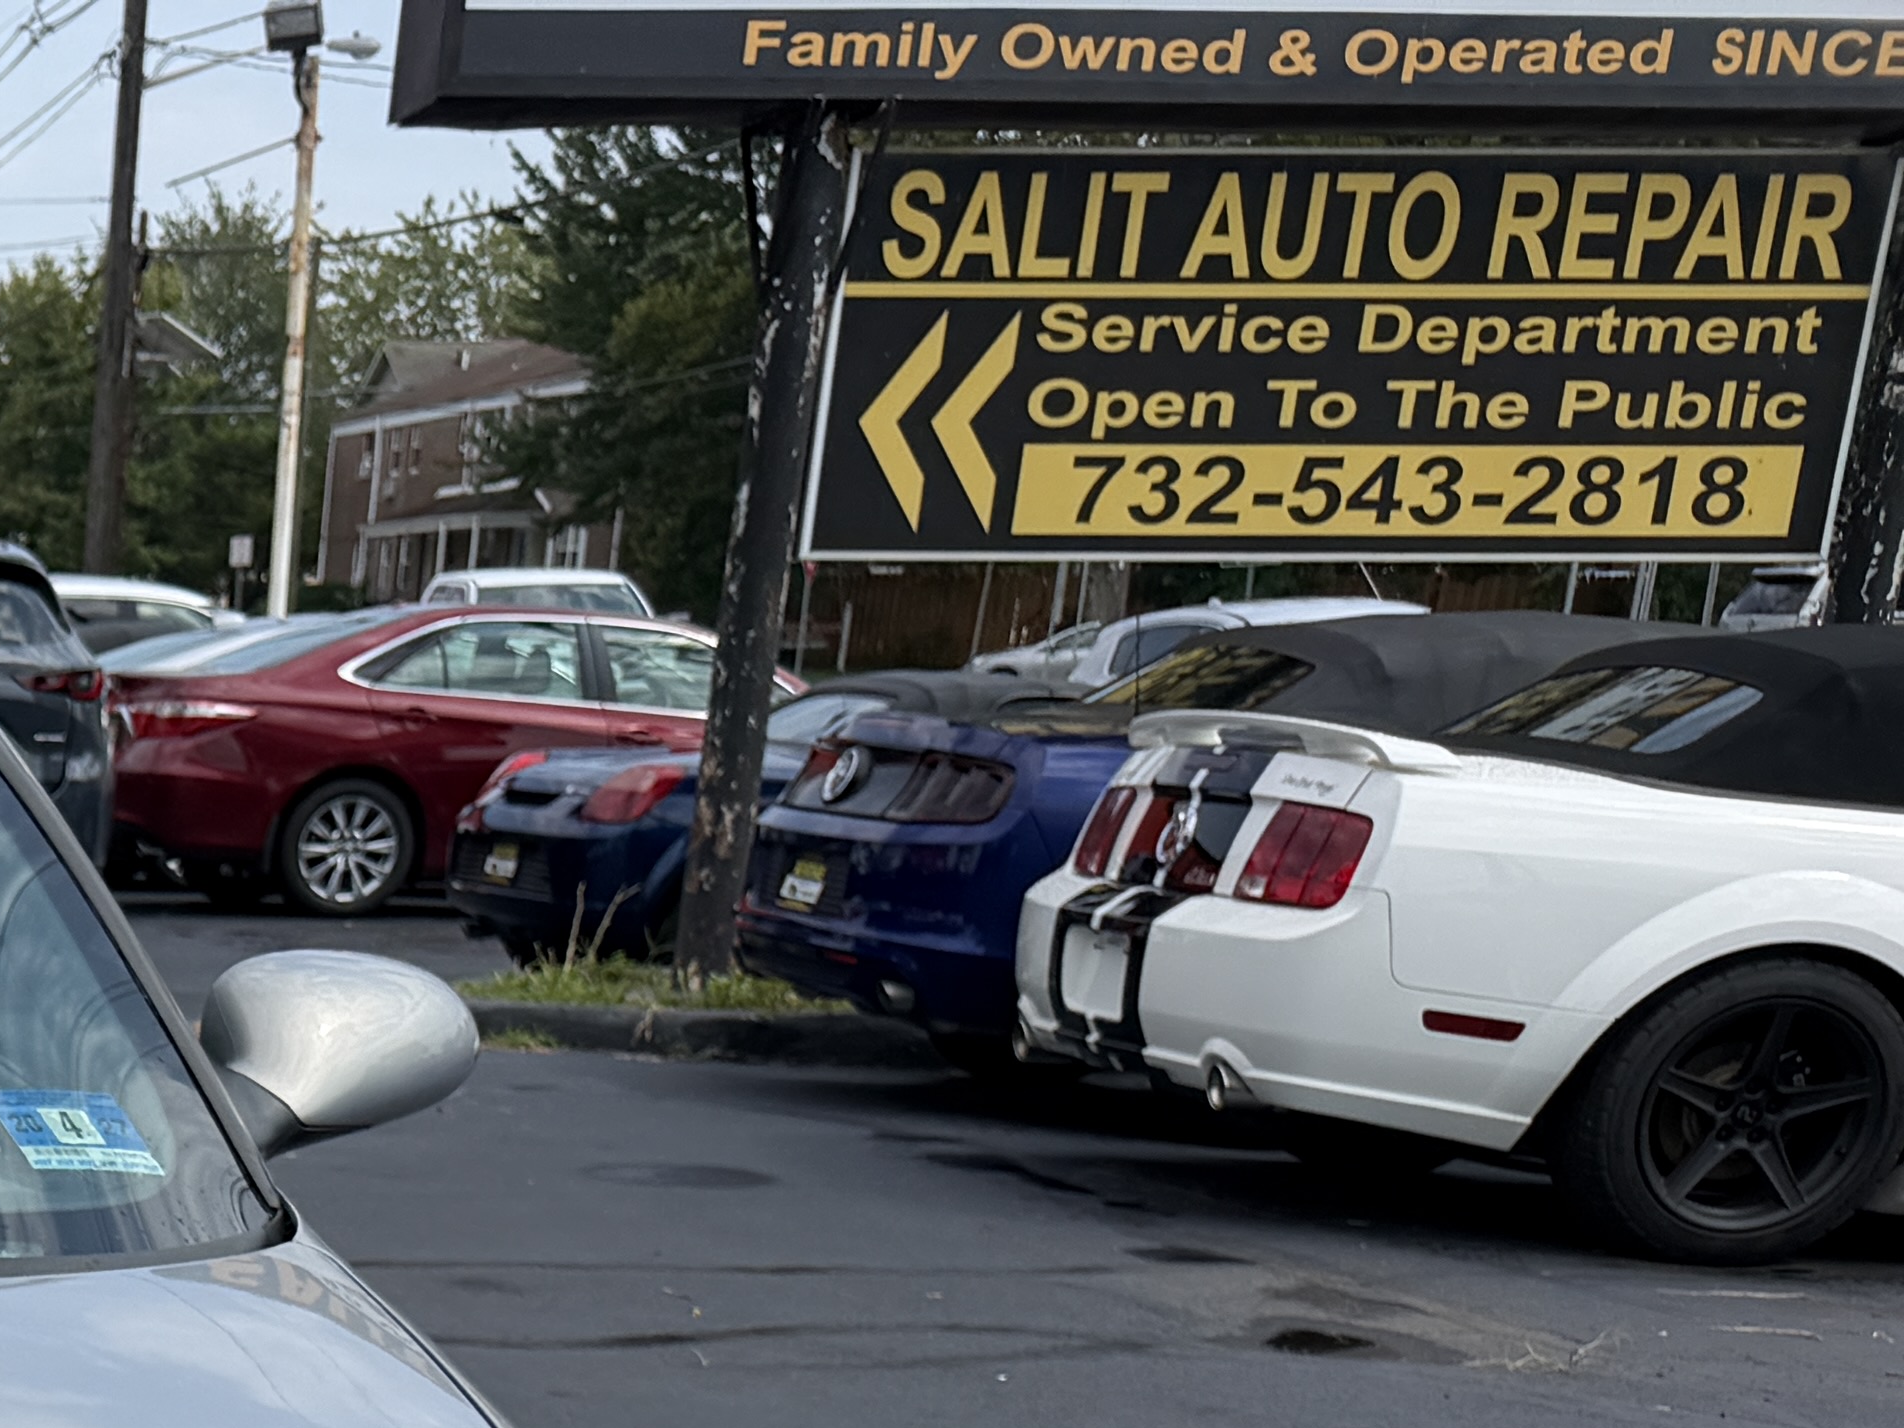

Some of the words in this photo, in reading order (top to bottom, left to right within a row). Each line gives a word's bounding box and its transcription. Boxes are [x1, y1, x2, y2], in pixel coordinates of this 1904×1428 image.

[742, 20, 979, 80] Family
[1000, 23, 1247, 74] Owned
[1268, 28, 1318, 76] &
[1344, 28, 1675, 84] Operated
[1711, 27, 1904, 77] SINCE
[881, 168, 1172, 280] SALIT
[1178, 169, 1462, 281] AUTO
[1485, 172, 1853, 281] REPAIR
[1036, 303, 1332, 354] Service
[1357, 303, 1823, 366] Department
[1027, 376, 1236, 439] Open
[1266, 378, 1358, 430] To
[1385, 378, 1530, 430] The
[1557, 380, 1808, 430] Public
[1070, 454, 1750, 527] 732-543-2818
[58, 1110, 85, 1139] 4
